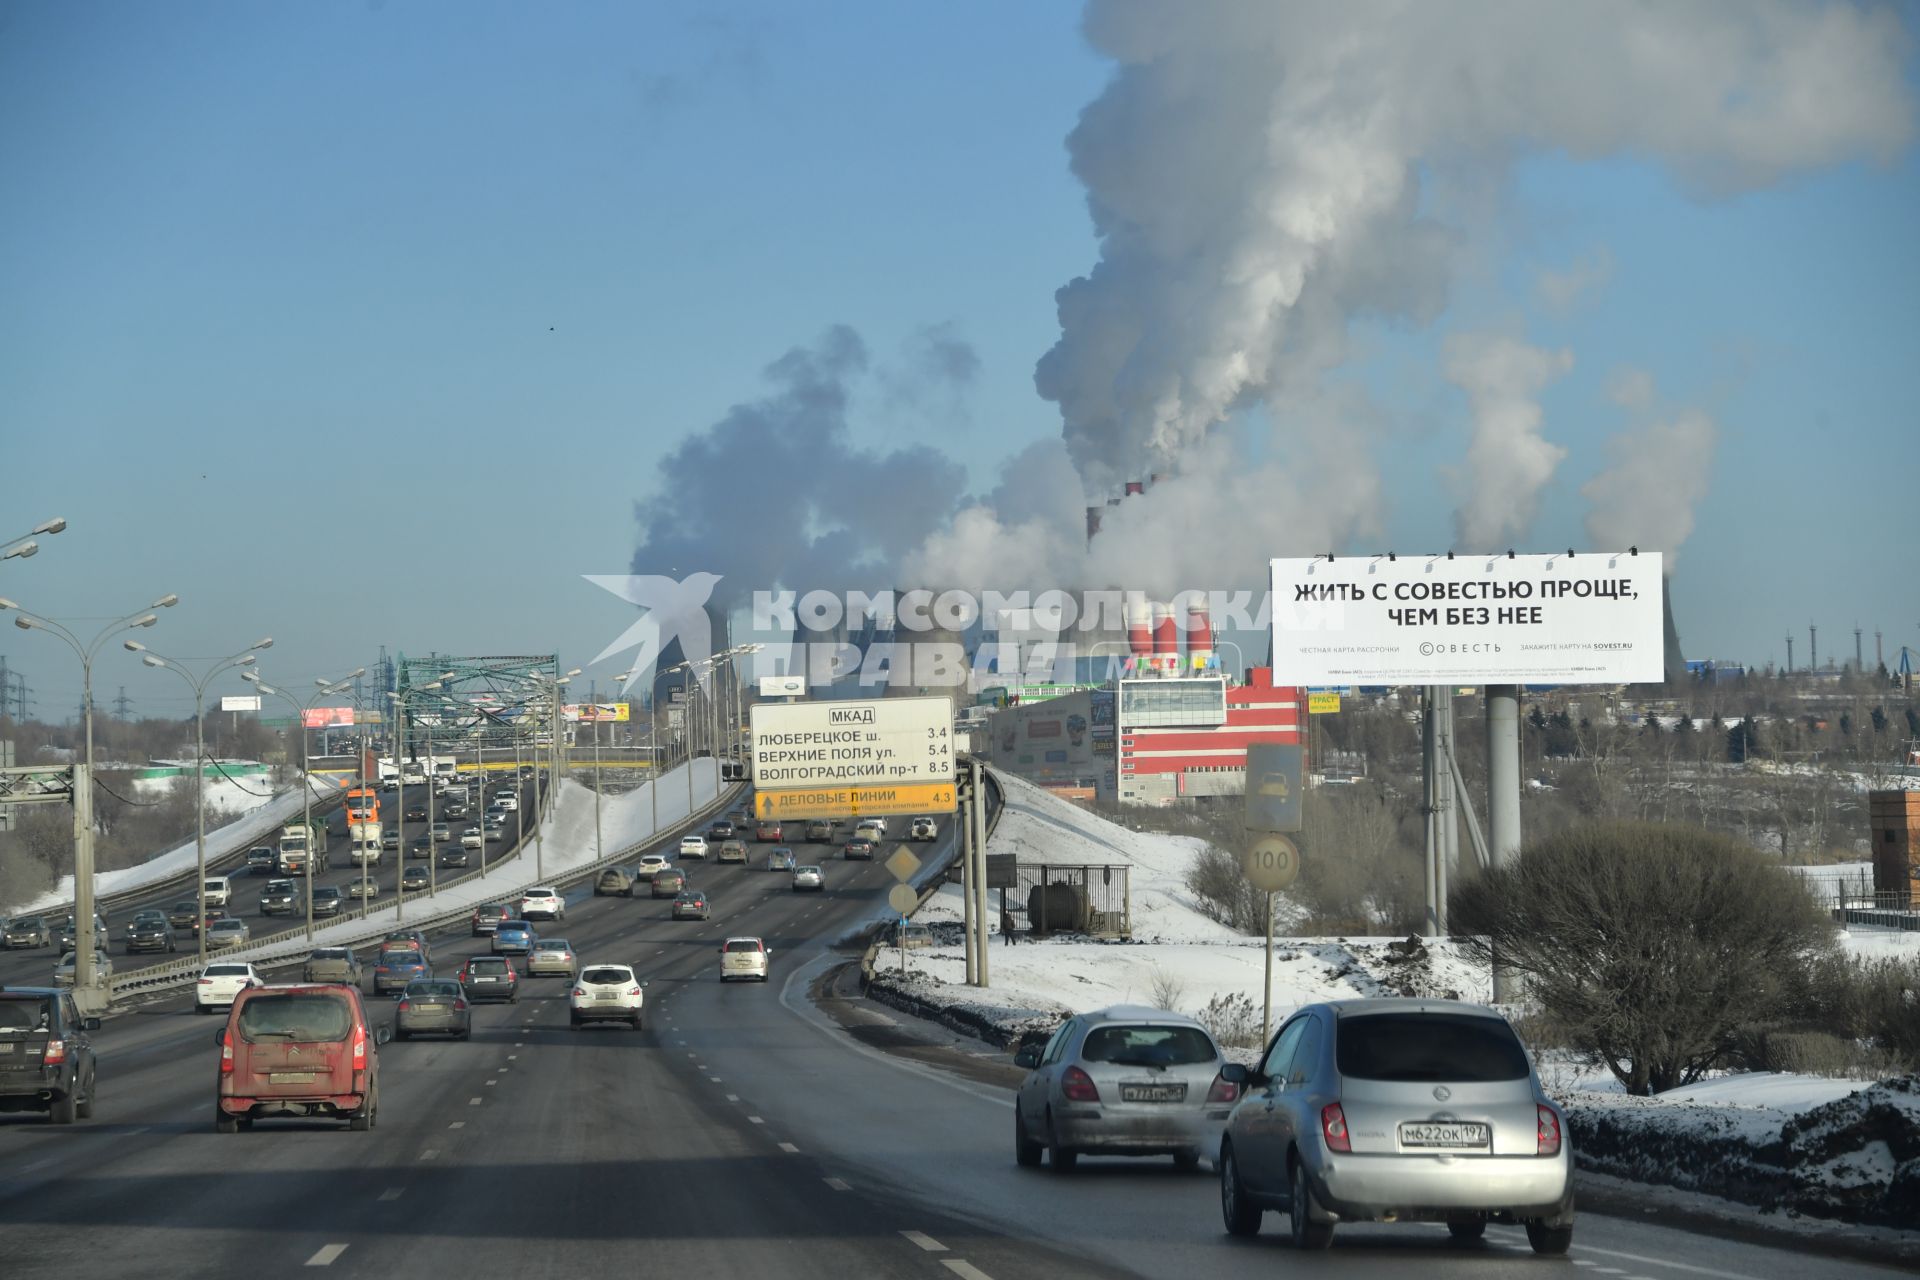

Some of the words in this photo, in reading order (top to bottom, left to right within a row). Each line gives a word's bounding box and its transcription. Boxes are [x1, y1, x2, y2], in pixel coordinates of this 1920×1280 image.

[1295, 583, 1365, 601] ЖИТЬ
[1372, 583, 1387, 600] С
[1394, 581, 1533, 600] СОВЕСТЬЮ
[1541, 579, 1638, 600] ПРОЩЕ,
[1388, 608, 1437, 626] ЧЕМ
[1446, 607, 1489, 625] БЕЗ
[1498, 607, 1542, 624] НЕЕ
[831, 709, 873, 724] МКАД
[758, 731, 861, 746] ЛЮБЕРЕЦКОЕ
[866, 732, 881, 741] ш.
[927, 727, 947, 738] 3.4
[758, 749, 827, 763] ВЕРХНИЕ
[831, 747, 871, 760] ПОЛЯ
[876, 749, 896, 760] ул.
[928, 744, 947, 755] 5.4
[759, 762, 885, 780] ВОЛГОГРАДСКИЙ
[889, 764, 918, 775] пр-т
[929, 762, 949, 773] 8.5
[779, 792, 846, 807] ДЕЛОВЫЕ
[851, 790, 896, 802] ЛИНИИ
[933, 791, 951, 802] 4.3
[1254, 851, 1288, 869] 100
